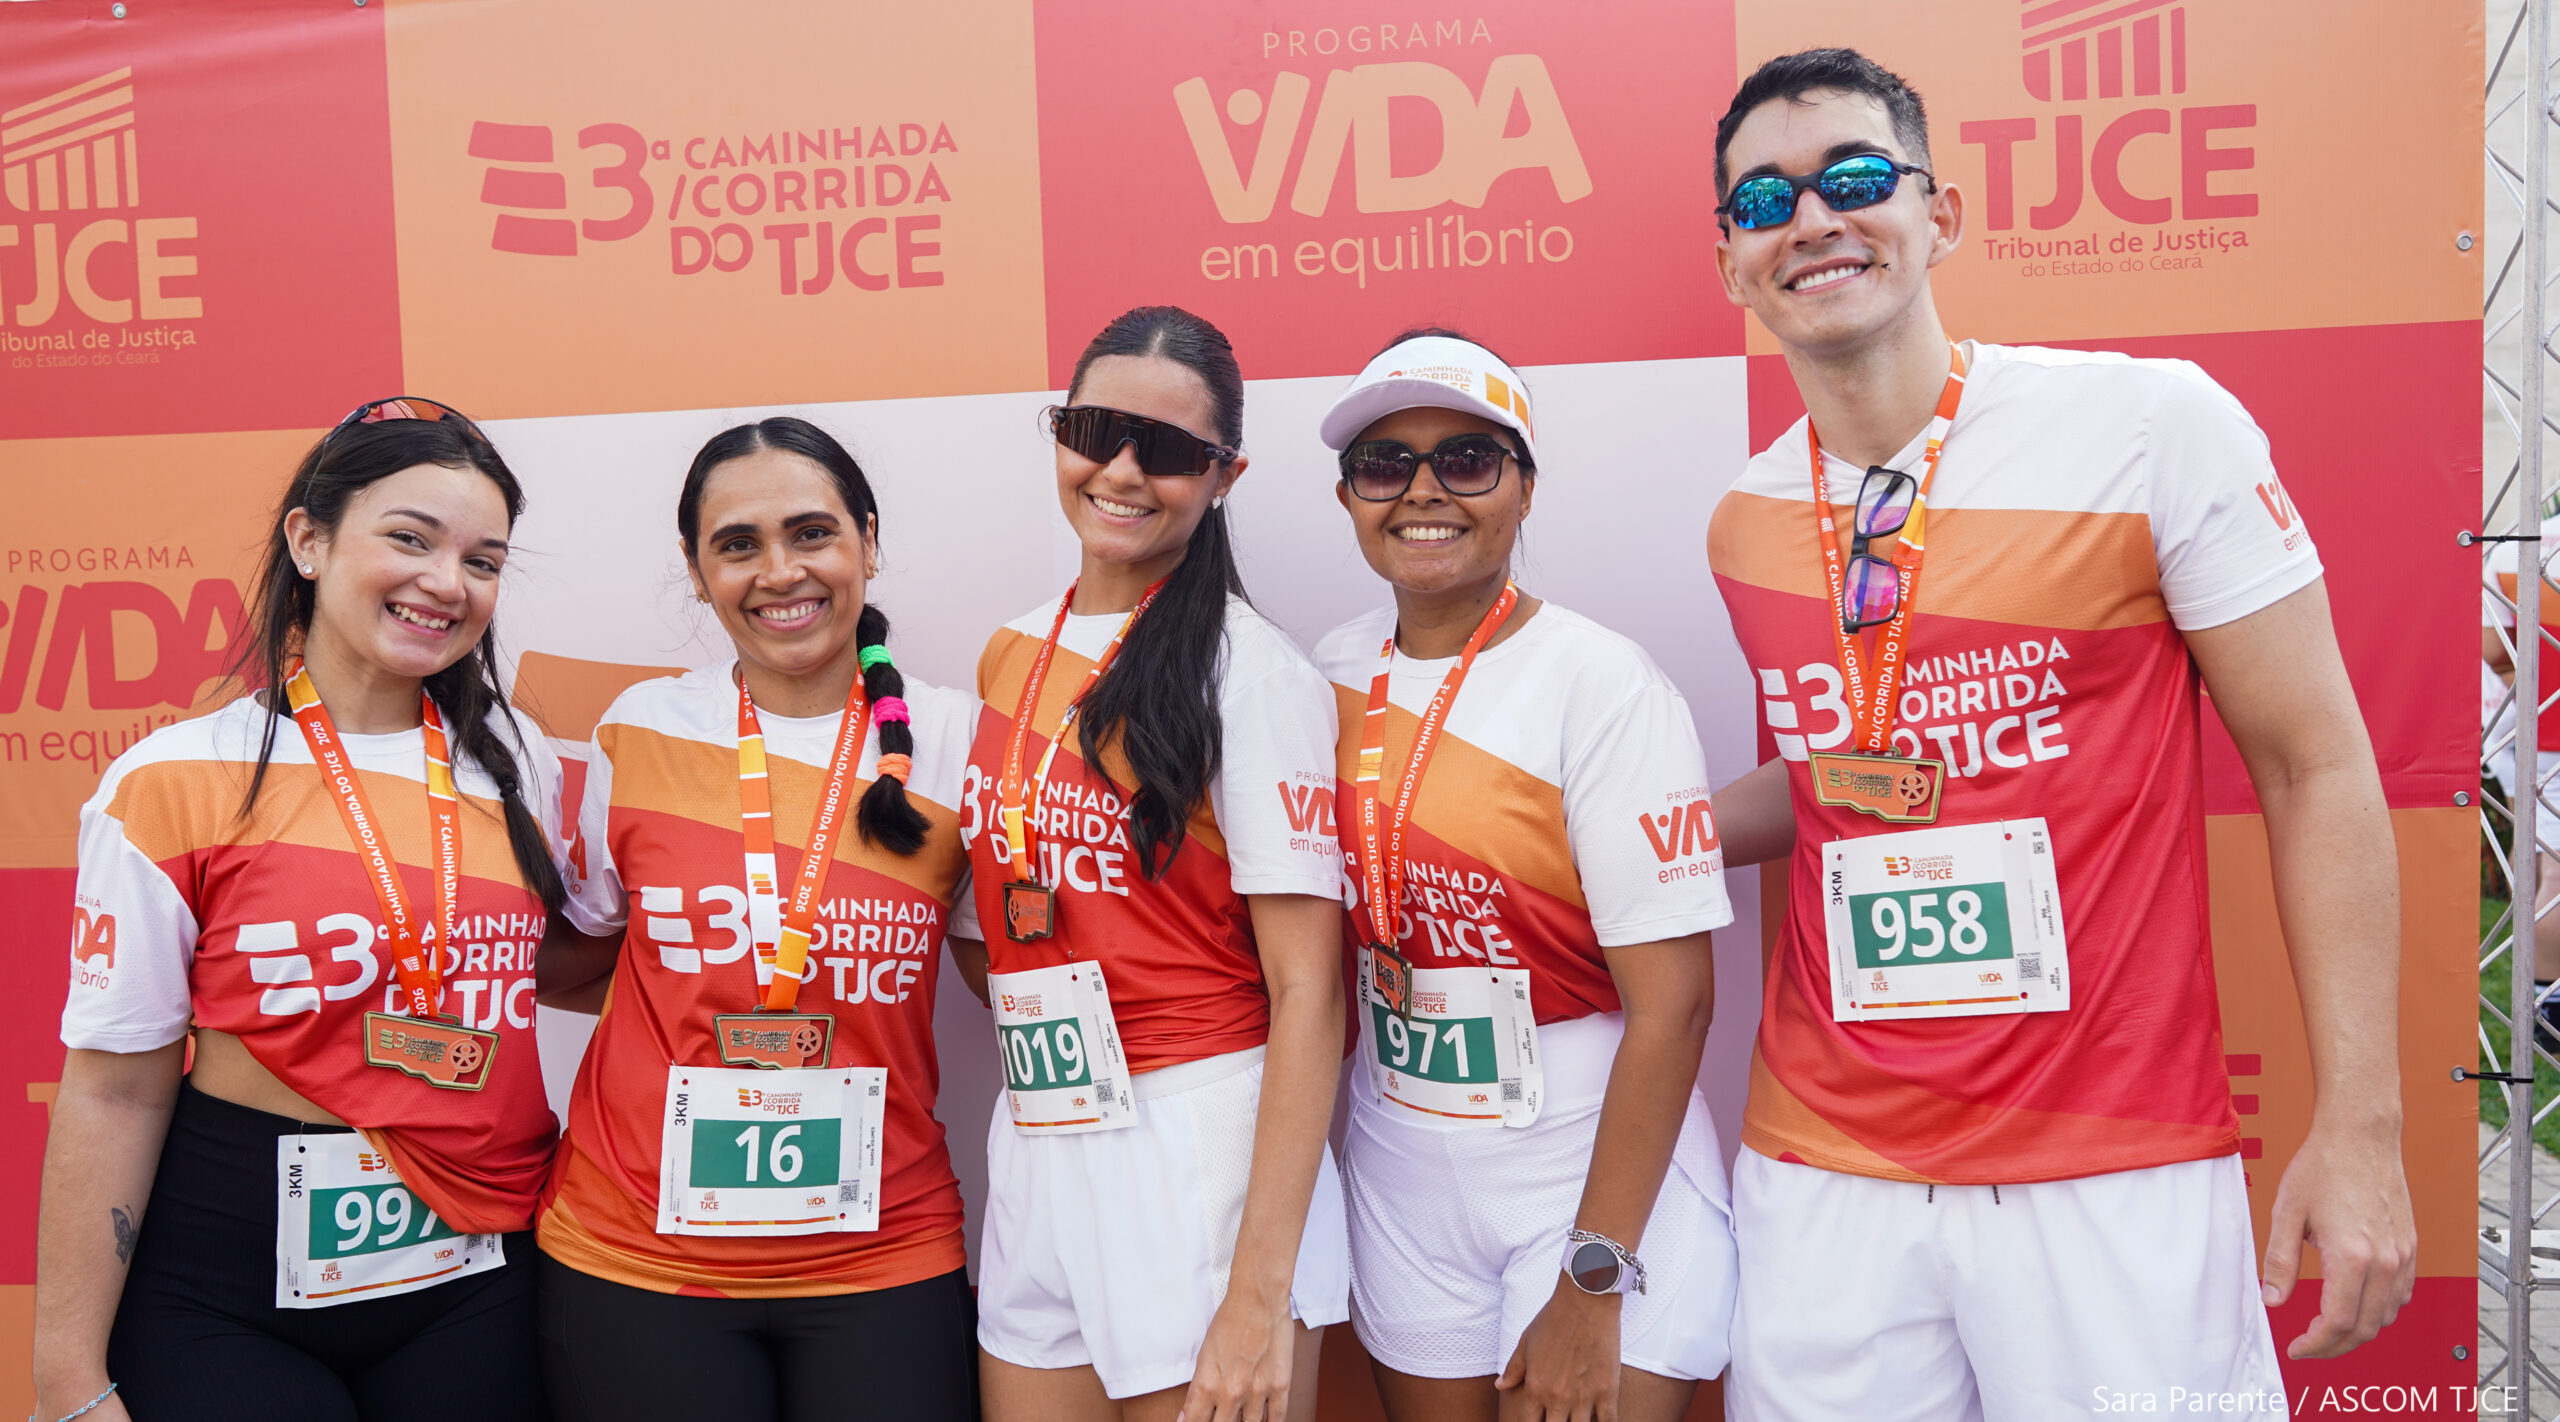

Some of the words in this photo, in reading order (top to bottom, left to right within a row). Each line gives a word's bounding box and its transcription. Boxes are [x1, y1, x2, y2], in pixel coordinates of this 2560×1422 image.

[1263, 18, 1493, 59] PROGRAMA
[1173, 53, 1594, 224] VIDA
[578, 122, 671, 242] 3ª
[684, 120, 958, 170] CAMINHADA
[1960, 104, 2259, 231] TJCE
[668, 160, 951, 221] /CORRIDA
[671, 222, 754, 275] DO
[763, 214, 945, 295] TJCE
[1200, 243, 1278, 281] em
[1294, 215, 1574, 288] equilíbrio
[1984, 231, 2099, 261] Tribunal
[2110, 232, 2144, 254] de
[2153, 226, 2249, 256] Justiça
[0, 217, 203, 327] JCE
[2021, 261, 2046, 279] do
[2052, 258, 2113, 277] Estado
[2120, 256, 2144, 274] do
[2149, 252, 2203, 272] Ceará
[0, 328, 76, 352] ibunal
[82, 329, 111, 349] de
[118, 325, 197, 350] Justiça
[12, 354, 33, 369] do
[37, 352, 88, 368] Estado
[91, 351, 113, 366] do
[116, 349, 160, 365] Ceará
[2284, 531, 2304, 551] em
[8, 545, 195, 573] PROGRAMA
[1899, 571, 1912, 602] 2026
[1889, 611, 1905, 639] TJCE
[1040, 643, 1050, 661] DO
[1884, 642, 1899, 662] DO
[309, 721, 331, 745] 2026
[1925, 705, 2070, 779] TJCE
[323, 750, 344, 775] TJCE
[817, 711, 860, 831] CAMINHADA/CORRIDA
[1393, 696, 1445, 829] CAMINHADA/CORRIDA
[336, 776, 353, 794] DO
[1865, 785, 1892, 797] TJCE
[1278, 780, 1338, 837] VID
[1364, 797, 1375, 826] 2026
[812, 833, 828, 851] DO
[1290, 838, 1310, 852] em
[1366, 834, 1377, 861] TJCE
[1391, 832, 1401, 851] DO
[804, 854, 822, 879] TJCE
[1390, 855, 1399, 881] TJCE
[1912, 860, 1953, 870] /CORRIDA
[1914, 854, 1954, 863] CAMINHADA
[1370, 864, 1379, 884] DO
[1658, 866, 1686, 884] em
[1832, 870, 1844, 905] 3KM
[1913, 870, 1926, 878] DO
[1926, 868, 1953, 880] TJCE
[795, 885, 812, 913] 2026
[74, 906, 116, 969] DA
[1415, 912, 1519, 965] TJCE
[1871, 890, 1988, 961] 958
[823, 957, 923, 1004] TJCE
[1360, 974, 1369, 1006] 3KM
[1870, 981, 1888, 991] TJCE
[1978, 972, 2003, 983] VIDA
[413, 987, 428, 1016] 2026
[453, 977, 536, 1029] TJC
[1017, 1007, 1025, 1015] DO
[1025, 1006, 1043, 1017] TJCE
[1423, 1003, 1447, 1013] TJCE
[417, 1049, 443, 1064] TJCE
[1001, 1023, 1085, 1086] 1019
[1386, 1014, 1470, 1078] 971
[1387, 1078, 1399, 1090] TJCE
[674, 1093, 689, 1126] 3KM
[776, 1104, 800, 1115] TJCE
[1467, 1094, 1489, 1103] VIDA
[735, 1124, 804, 1183] 16
[288, 1163, 303, 1198] 3KM
[699, 1201, 719, 1210] TJCE
[320, 1271, 343, 1282] TJCE
